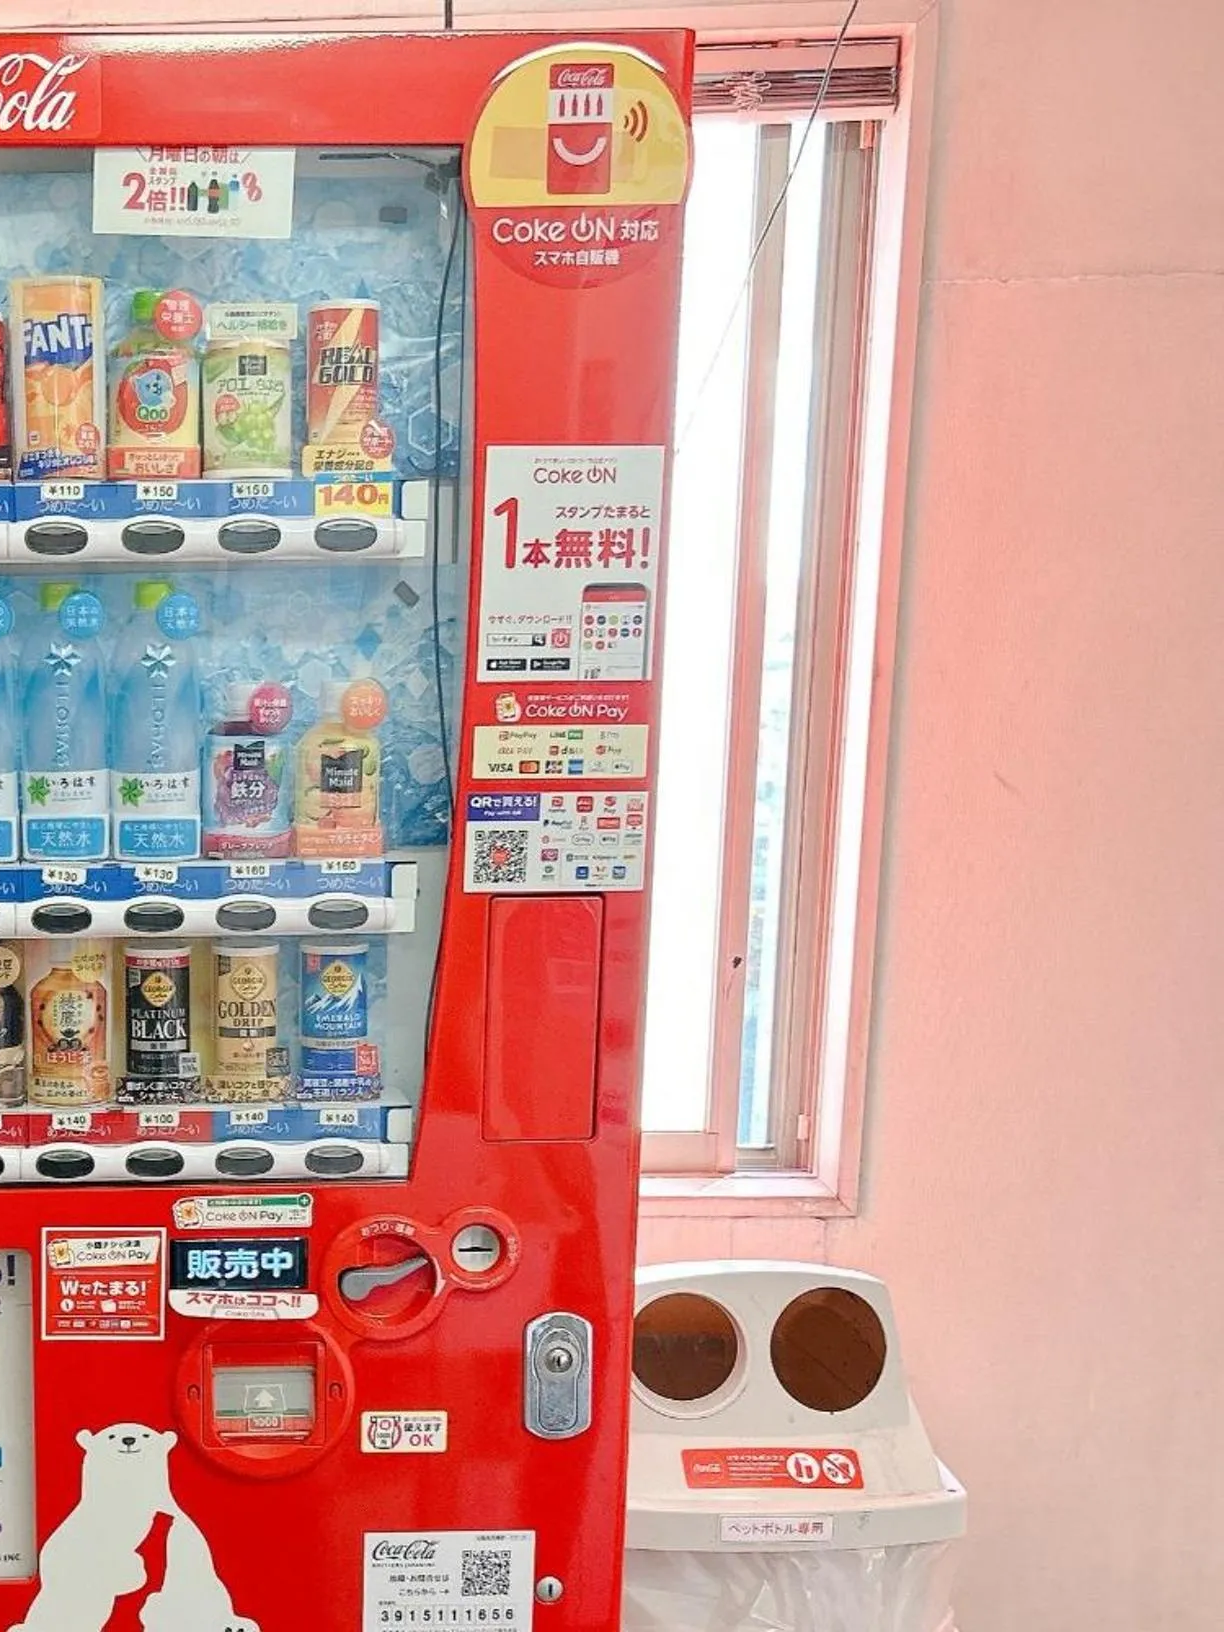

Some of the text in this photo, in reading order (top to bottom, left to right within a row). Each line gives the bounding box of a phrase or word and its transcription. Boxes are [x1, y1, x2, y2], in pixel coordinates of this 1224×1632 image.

[493, 217, 566, 243] Coke
[620, 220, 660, 241] 対応
[534, 250, 620, 266] スマホ自販機
[137, 405, 168, 422] Qoo
[534, 465, 616, 484] Coke ON
[142, 487, 174, 497] ¥150
[555, 506, 651, 519] スタンプたまると
[526, 701, 628, 721] Coke ON Pay
[325, 767, 359, 777] Minute
[488, 763, 513, 772] VISA
[329, 777, 354, 787] Maid
[230, 781, 265, 799] 鉄分
[470, 796, 537, 808] QRで買える!
[41, 831, 91, 848] 天然水
[133, 833, 184, 848] 天然水
[131, 1009, 185, 1018] PLATINUM
[218, 1002, 275, 1018] GOLDEN
[131, 1019, 187, 1039] BLACK
[233, 1018, 264, 1027] DRIP
[144, 1114, 173, 1123] ¥100
[206, 1212, 236, 1222] Coke
[259, 1211, 283, 1222] Pay
[77, 1252, 106, 1261] Coke
[129, 1250, 150, 1261] Pay
[187, 1247, 293, 1279] 販売中
[60, 1280, 146, 1296] Wでたまる!
[186, 1292, 301, 1307] スマホはココへ!!
[404, 1423, 441, 1432] 使えます
[409, 1434, 434, 1447] OK
[729, 1523, 824, 1535] ペットボトル専用
[372, 1540, 440, 1561] Coca-Cola
